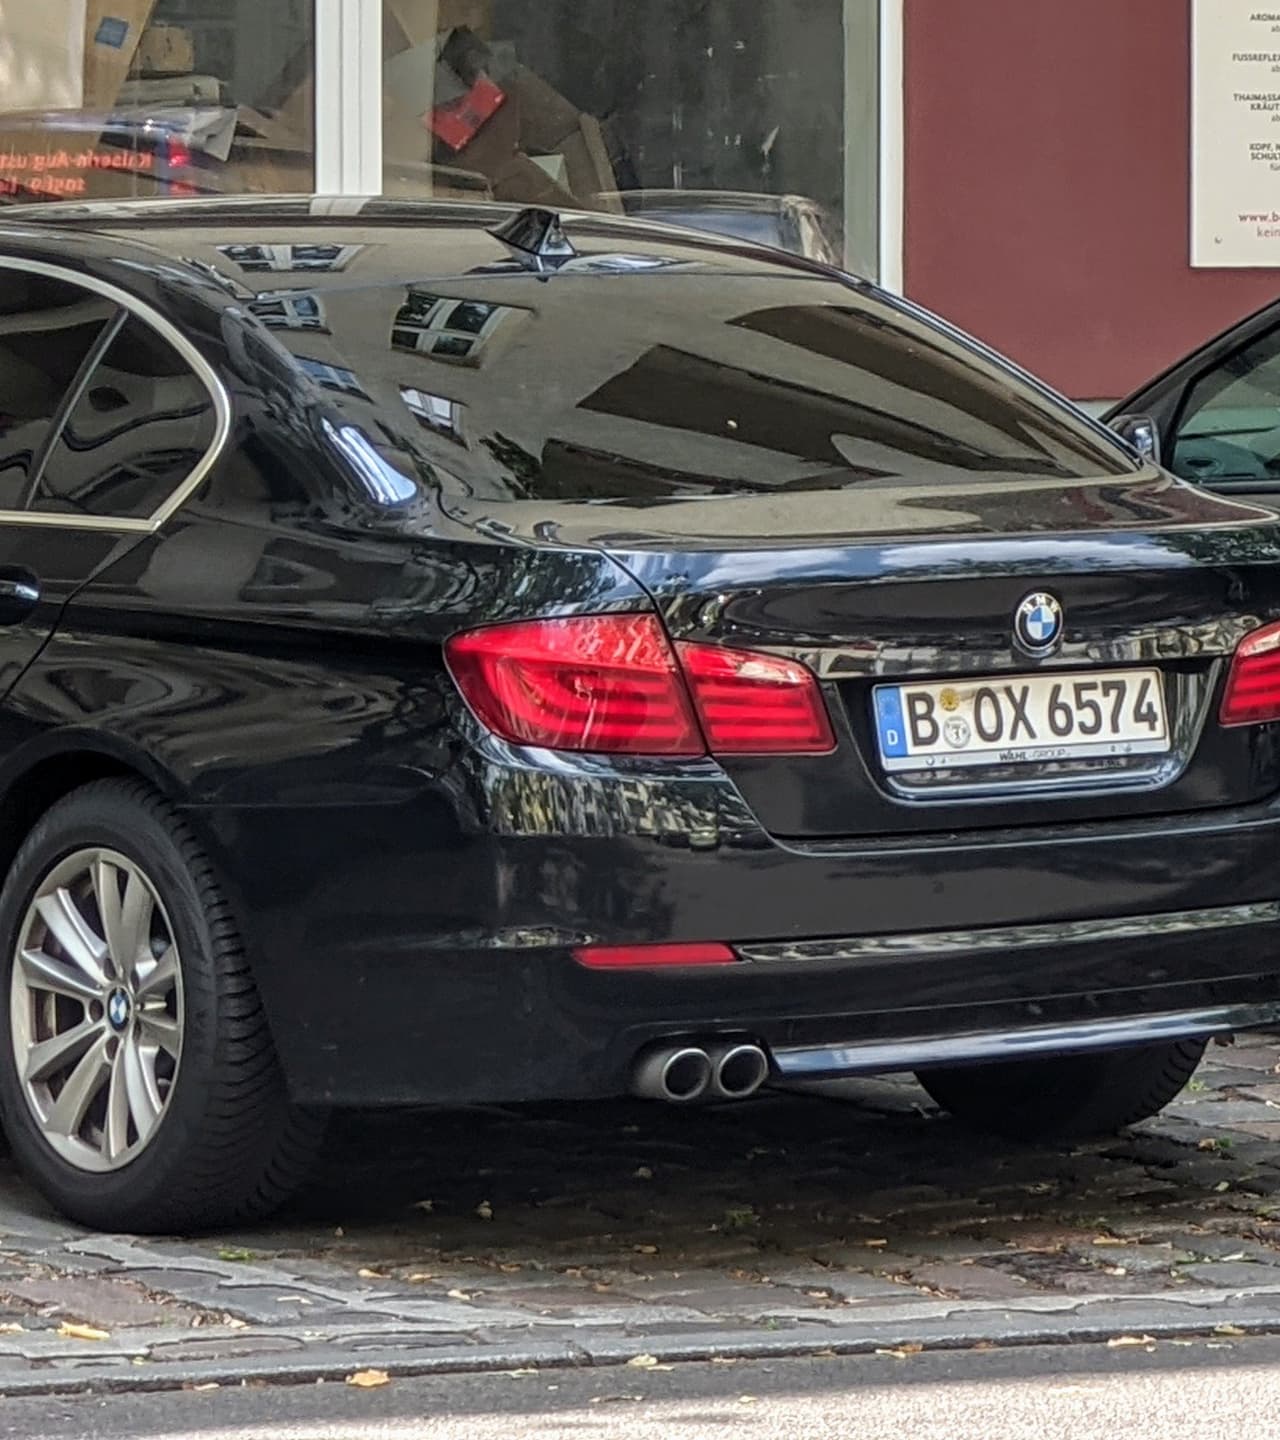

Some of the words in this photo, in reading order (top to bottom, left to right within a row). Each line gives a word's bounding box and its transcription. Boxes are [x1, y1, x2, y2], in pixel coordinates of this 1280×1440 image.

[886, 728, 899, 746] D
[906, 691, 940, 748] B
[973, 684, 1037, 743] OX
[1047, 678, 1159, 738] 6574
